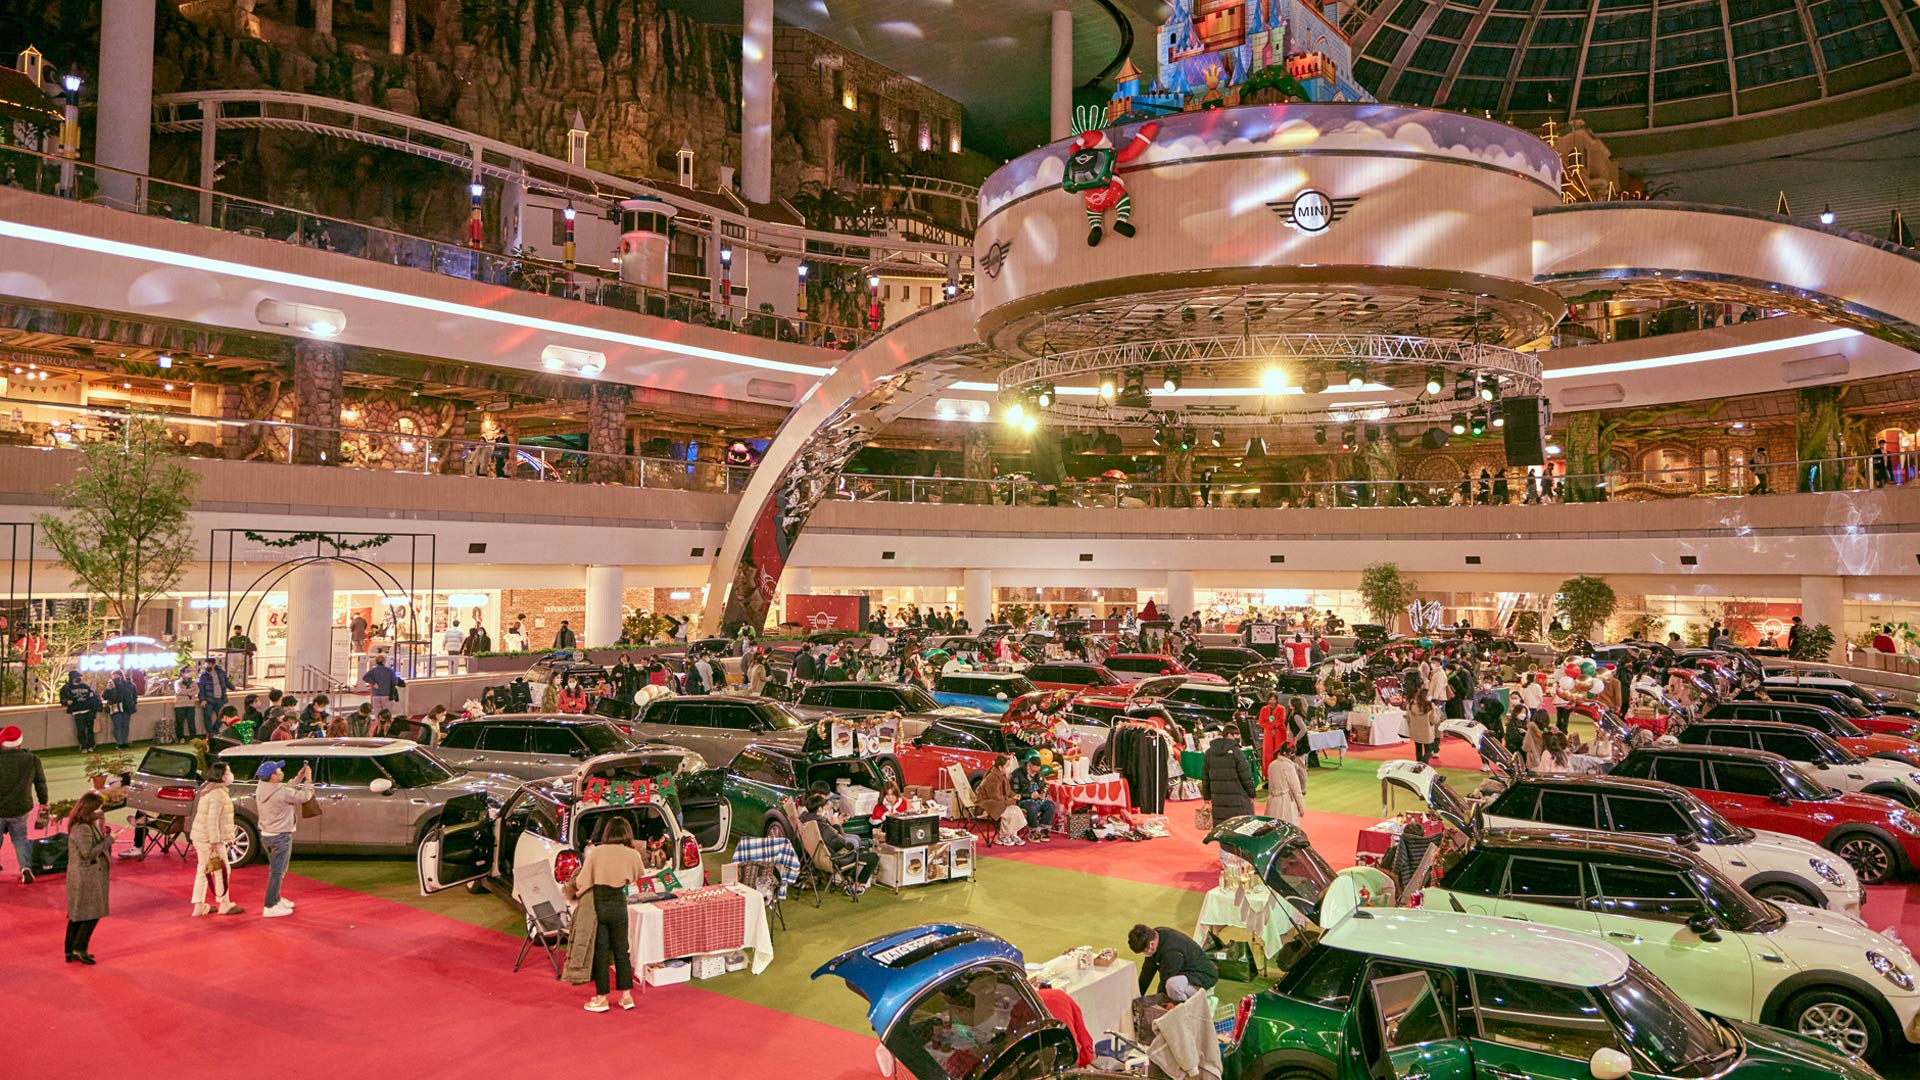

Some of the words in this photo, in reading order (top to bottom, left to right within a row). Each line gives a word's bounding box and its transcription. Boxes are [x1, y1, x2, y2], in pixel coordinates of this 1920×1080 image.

[1298, 205, 1328, 217] MINI
[79, 654, 120, 672] ICE
[123, 652, 178, 670] RINK
